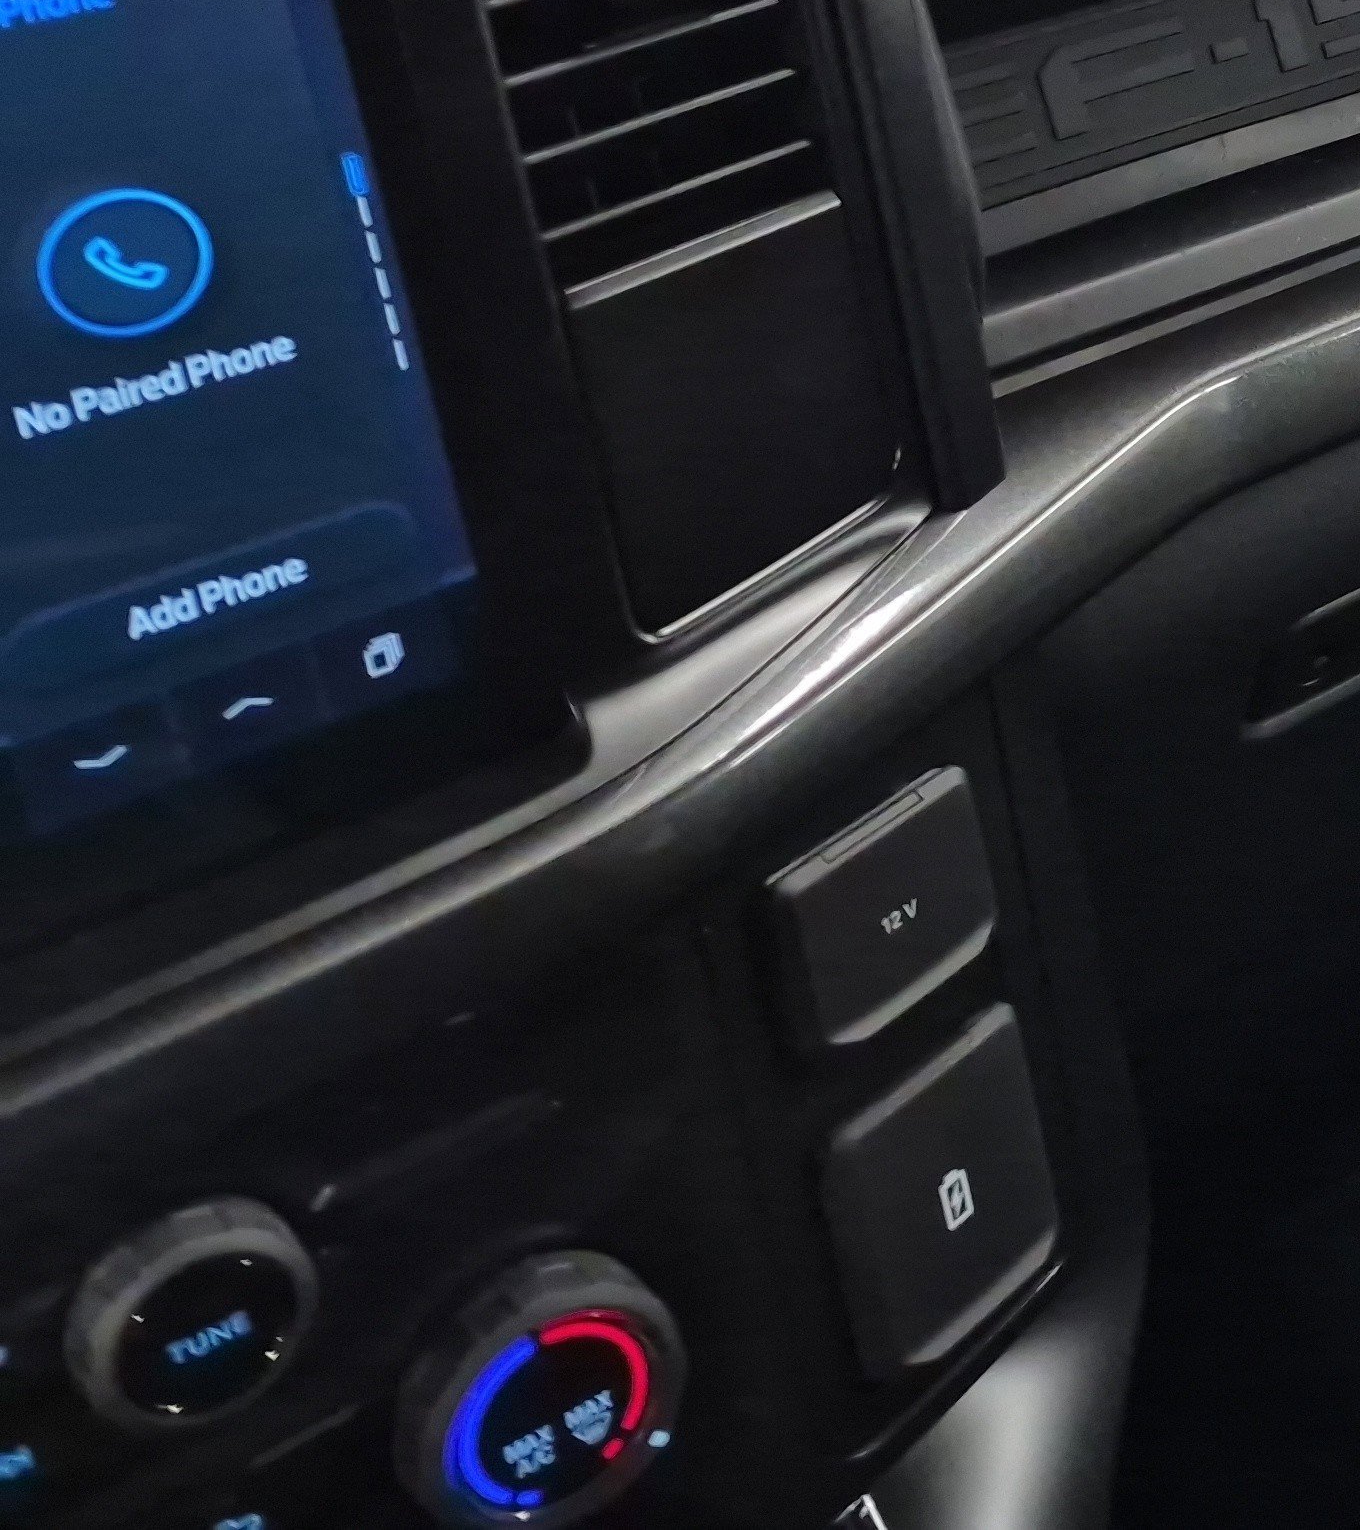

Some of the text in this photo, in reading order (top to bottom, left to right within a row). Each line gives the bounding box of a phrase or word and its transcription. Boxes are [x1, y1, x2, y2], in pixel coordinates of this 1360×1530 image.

[11, 335, 299, 440] No Paired Phone
[128, 558, 309, 641] Add Phone
[880, 897, 918, 935] 12 V
